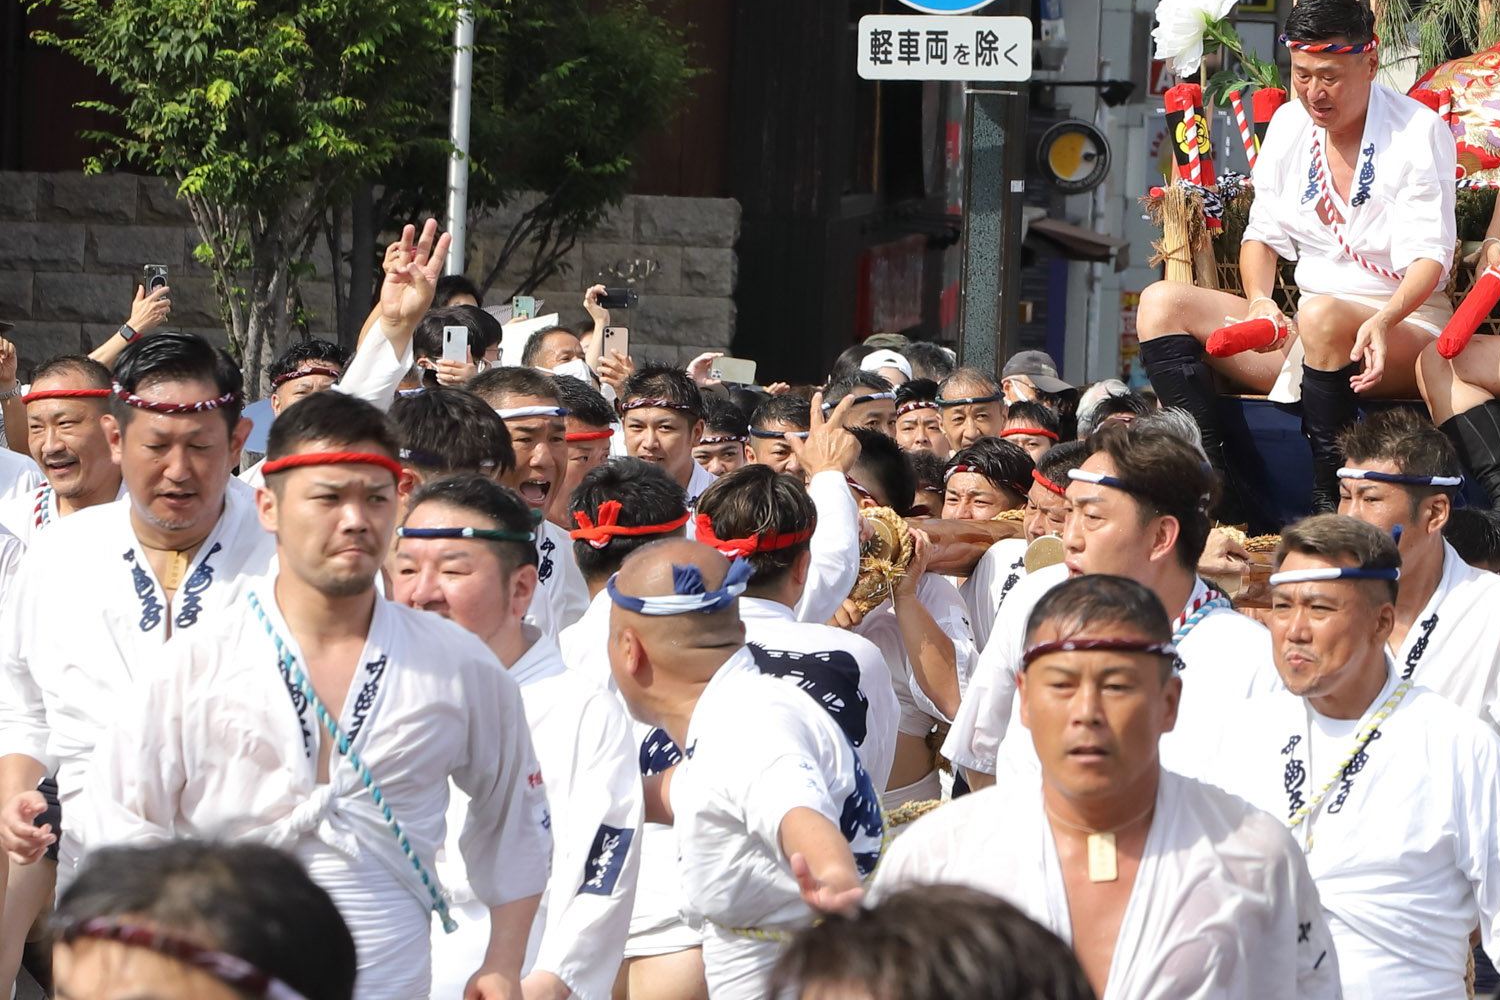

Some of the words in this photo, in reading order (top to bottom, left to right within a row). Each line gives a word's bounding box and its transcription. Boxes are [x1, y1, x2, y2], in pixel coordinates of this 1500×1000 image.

[869, 28, 1019, 67] 軽車両を除く
